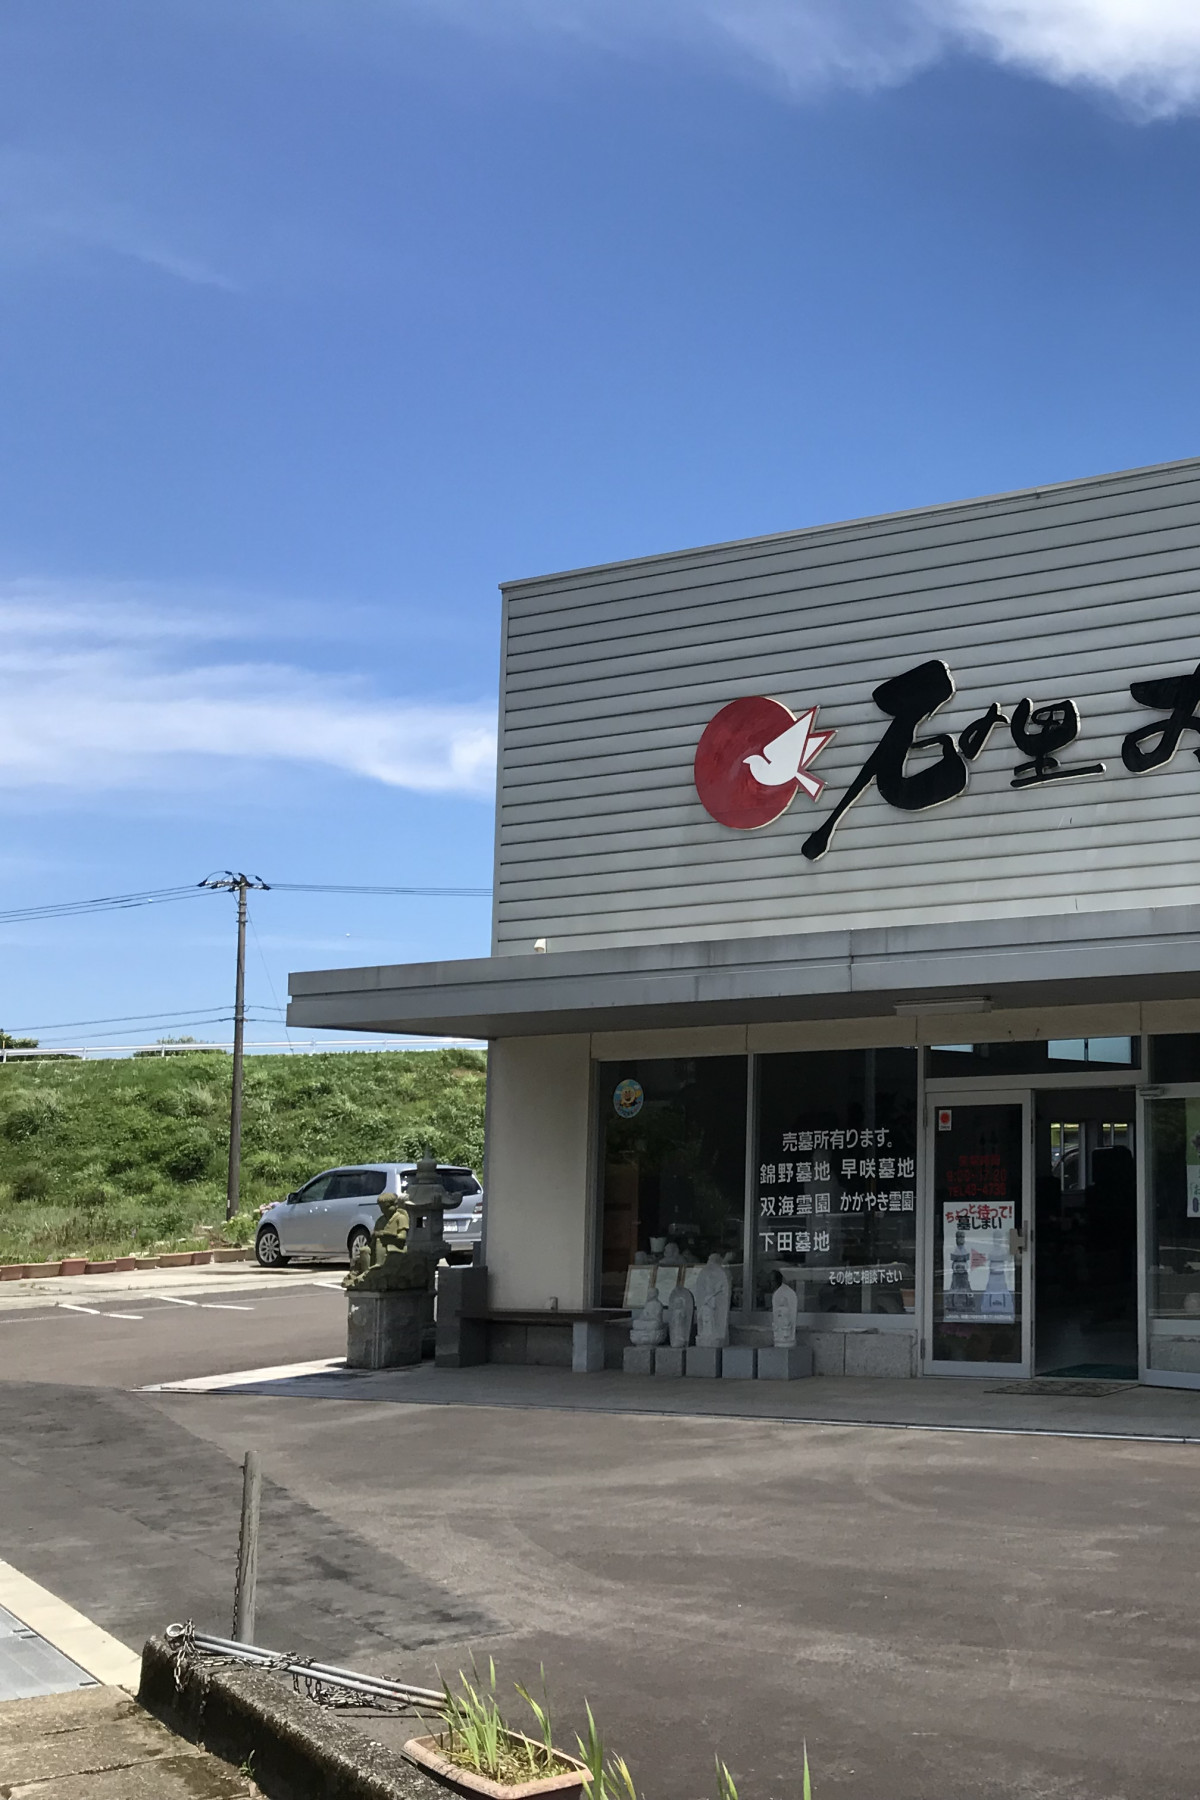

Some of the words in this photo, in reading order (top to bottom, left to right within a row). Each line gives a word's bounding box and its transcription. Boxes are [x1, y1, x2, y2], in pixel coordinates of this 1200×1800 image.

[782, 1128, 893, 1152] 売墓所有ります。
[760, 1161, 831, 1184] 錦野墓地
[841, 1157, 915, 1179] 早咲墓地
[760, 1193, 831, 1216] 双海霊園
[840, 1191, 914, 1212] かがやき霊園
[759, 1230, 830, 1252] 下田墓地
